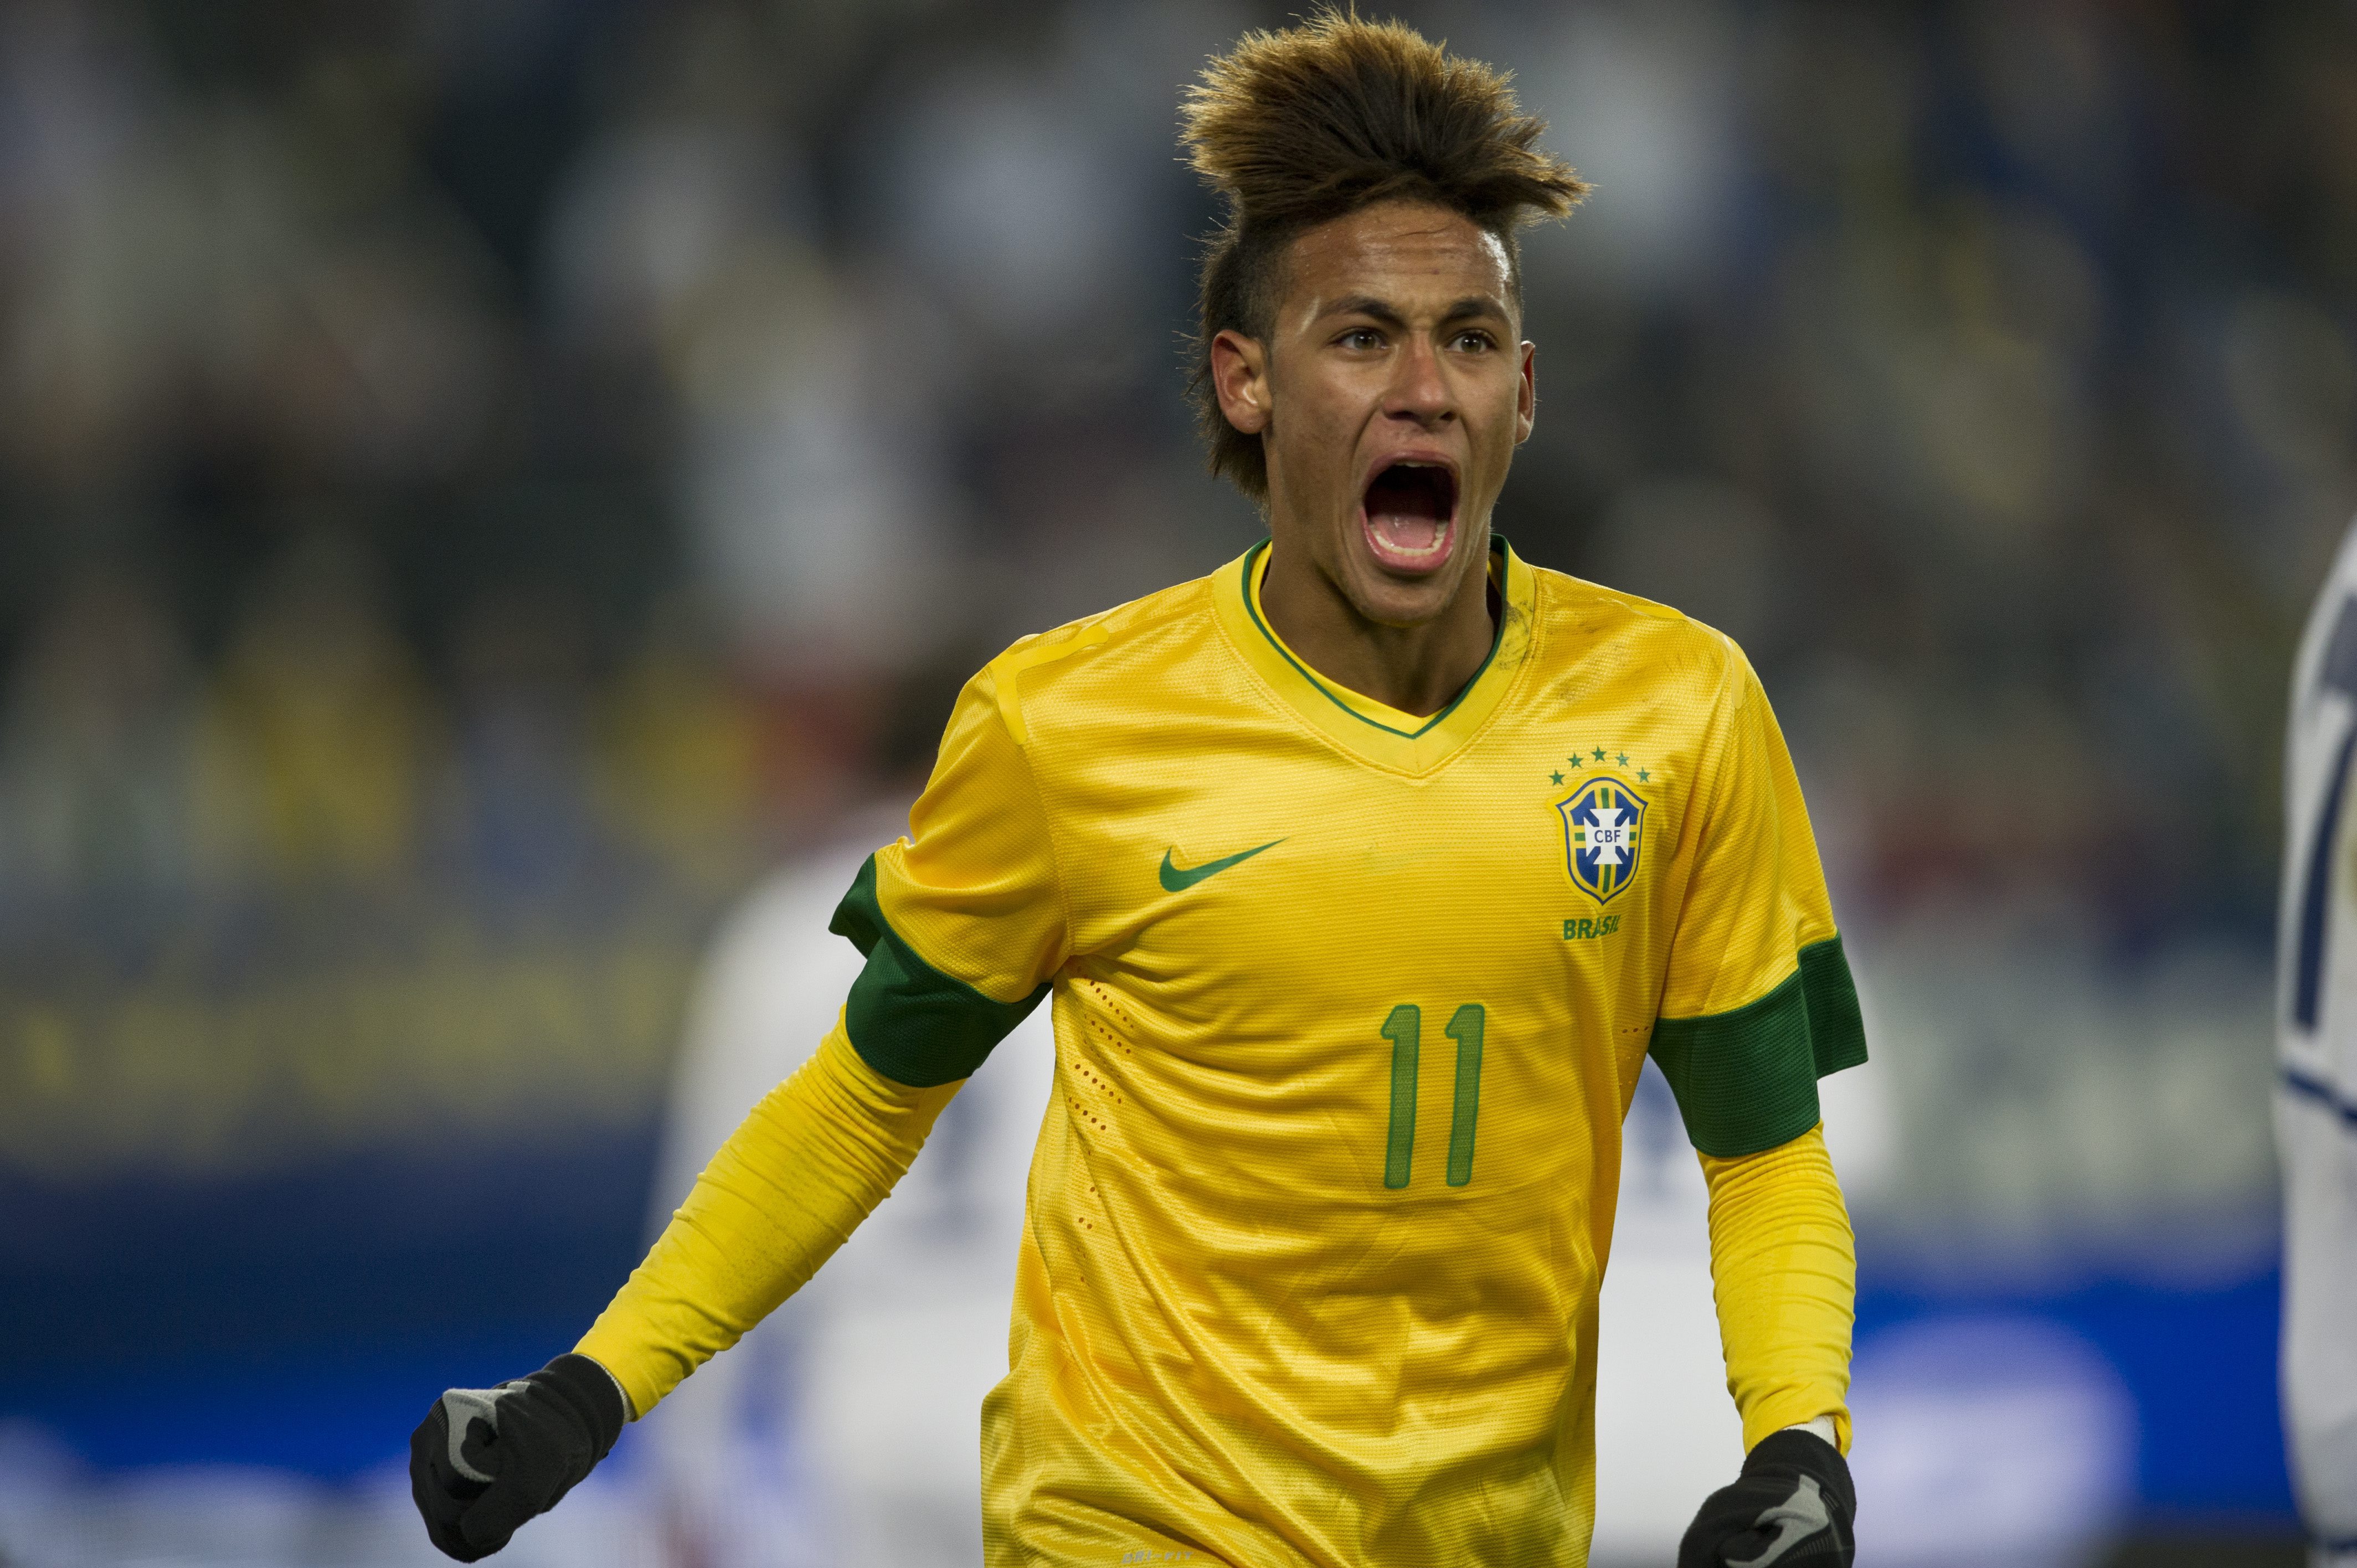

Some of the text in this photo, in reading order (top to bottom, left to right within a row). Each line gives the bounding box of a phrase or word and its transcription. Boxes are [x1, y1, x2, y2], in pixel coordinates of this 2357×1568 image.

[1594, 829, 1621, 843] CBF
[1563, 914, 1621, 940] BRASIL
[1380, 1004, 1485, 1189] 11
[1121, 1550, 1194, 1564] DRI-FIT
